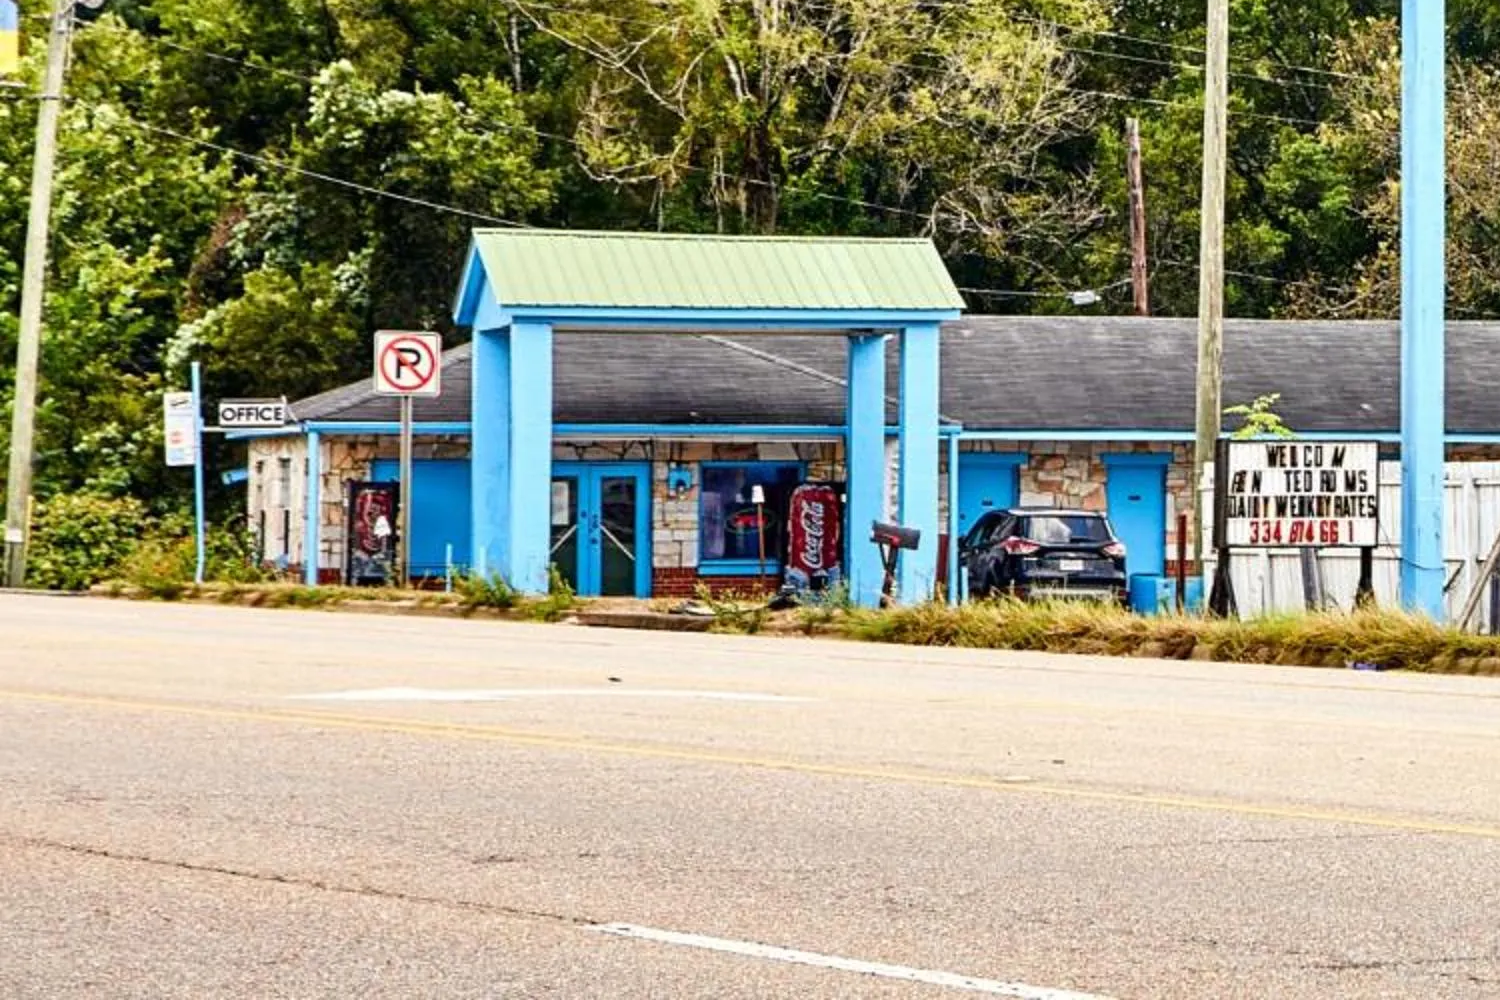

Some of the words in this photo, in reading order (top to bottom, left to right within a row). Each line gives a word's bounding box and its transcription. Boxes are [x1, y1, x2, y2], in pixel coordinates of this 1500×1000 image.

[221, 407, 283, 421] OFFICE
[1334, 495, 1377, 518] RATES
[1250, 520, 1281, 544] 334
